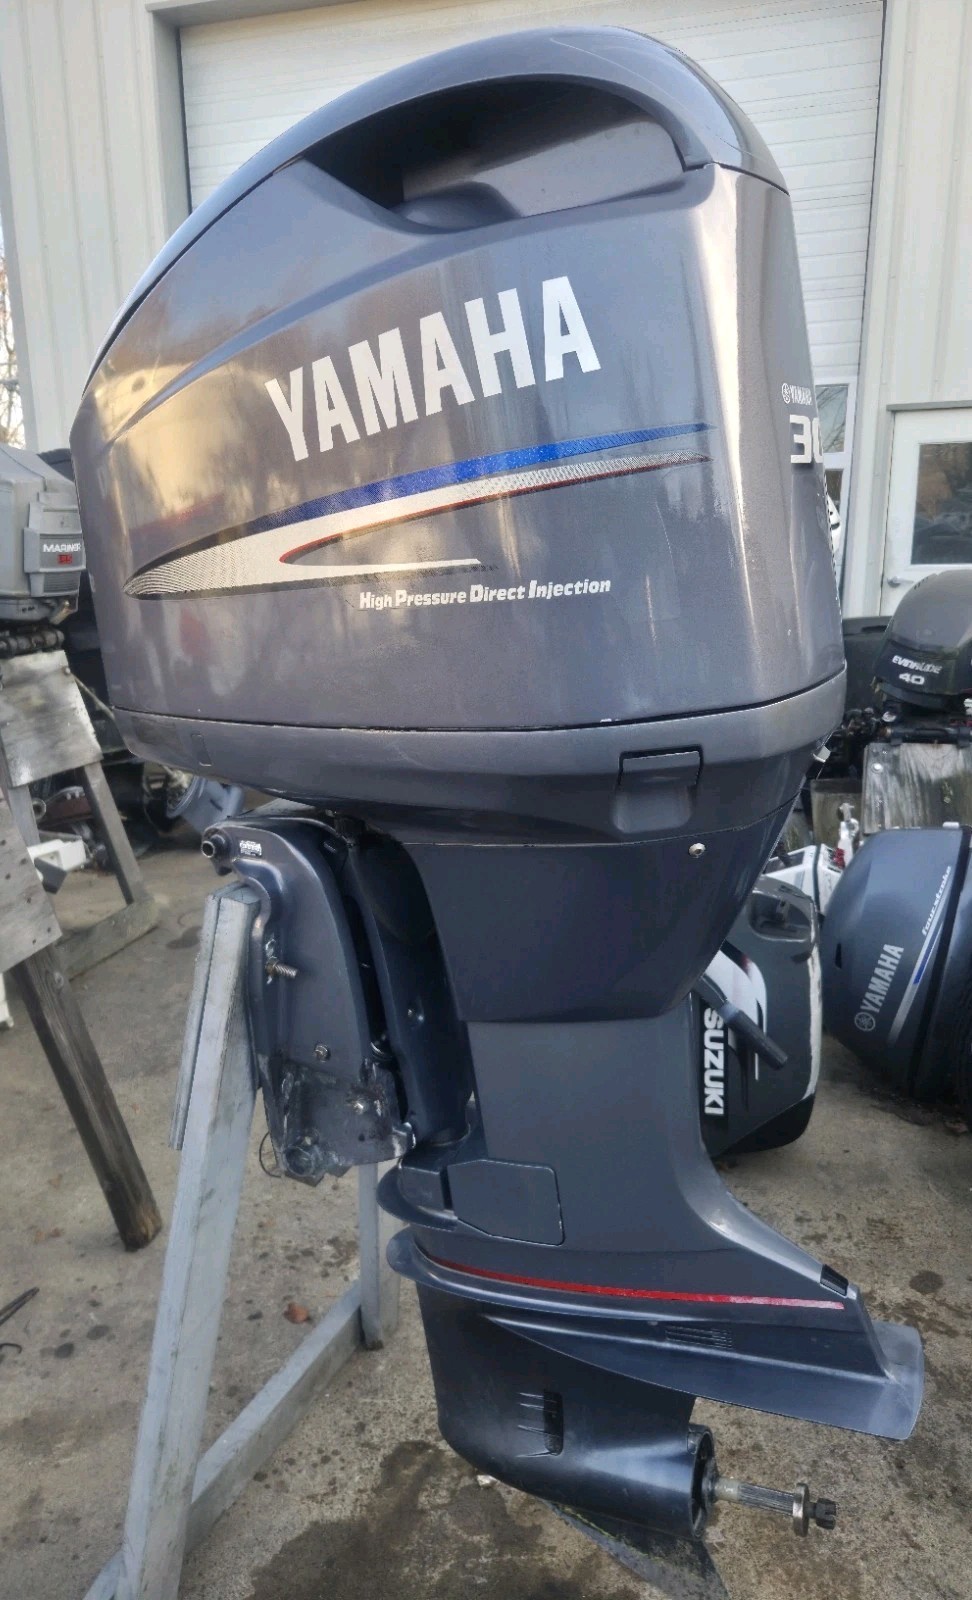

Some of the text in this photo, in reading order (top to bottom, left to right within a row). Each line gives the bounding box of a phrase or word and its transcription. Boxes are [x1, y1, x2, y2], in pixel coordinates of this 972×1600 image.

[264, 275, 601, 462] YAMAHA
[43, 542, 81, 552] MARINER
[359, 578, 611, 611] High Pressure Direct Injection
[899, 672, 925, 686] 40
[860, 943, 905, 1013] YAMAHA
[704, 1007, 725, 1116] SUZUKI
